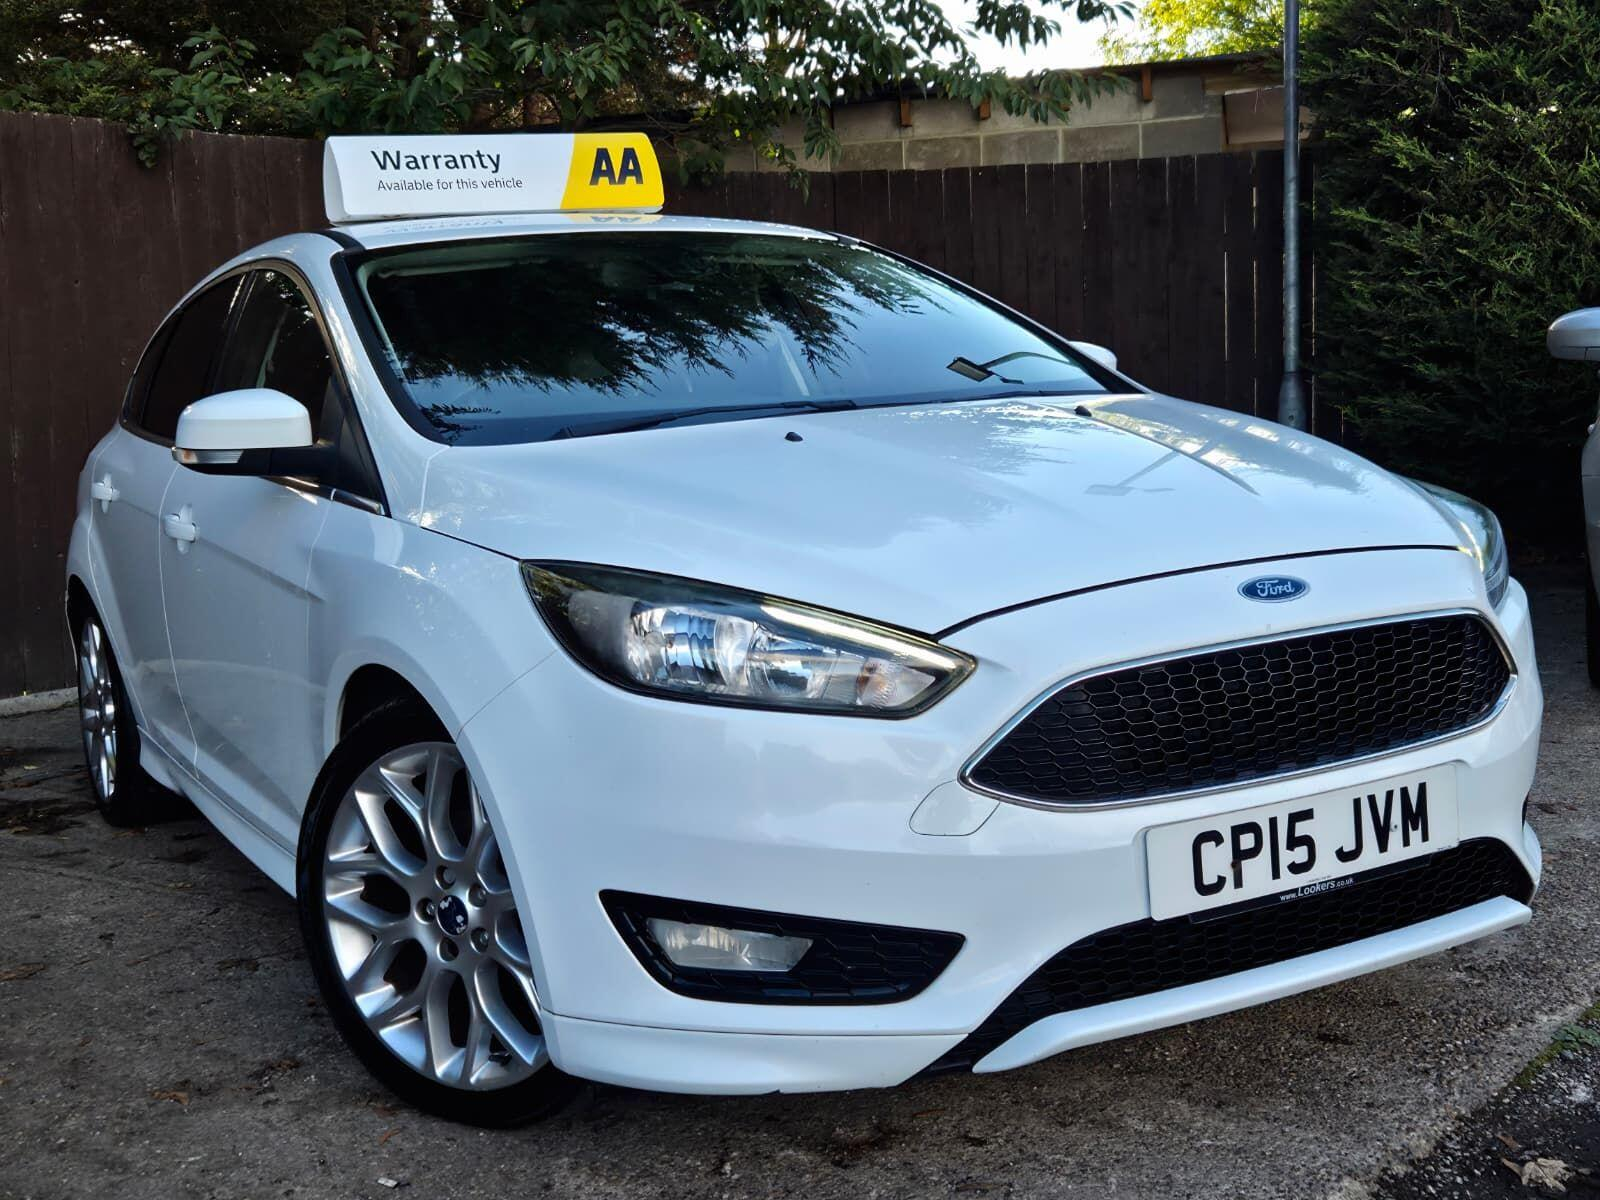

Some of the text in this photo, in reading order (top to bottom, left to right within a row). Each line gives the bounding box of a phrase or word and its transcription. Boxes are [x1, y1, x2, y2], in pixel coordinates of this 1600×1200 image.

[371, 149, 501, 174] Warranty
[589, 147, 644, 186] AA
[377, 177, 524, 192] Available for this vehicle
[1255, 579, 1296, 598] Ford
[1191, 781, 1430, 898] CP15 JVM
[1280, 877, 1355, 902] www.Lookers.co.uk
